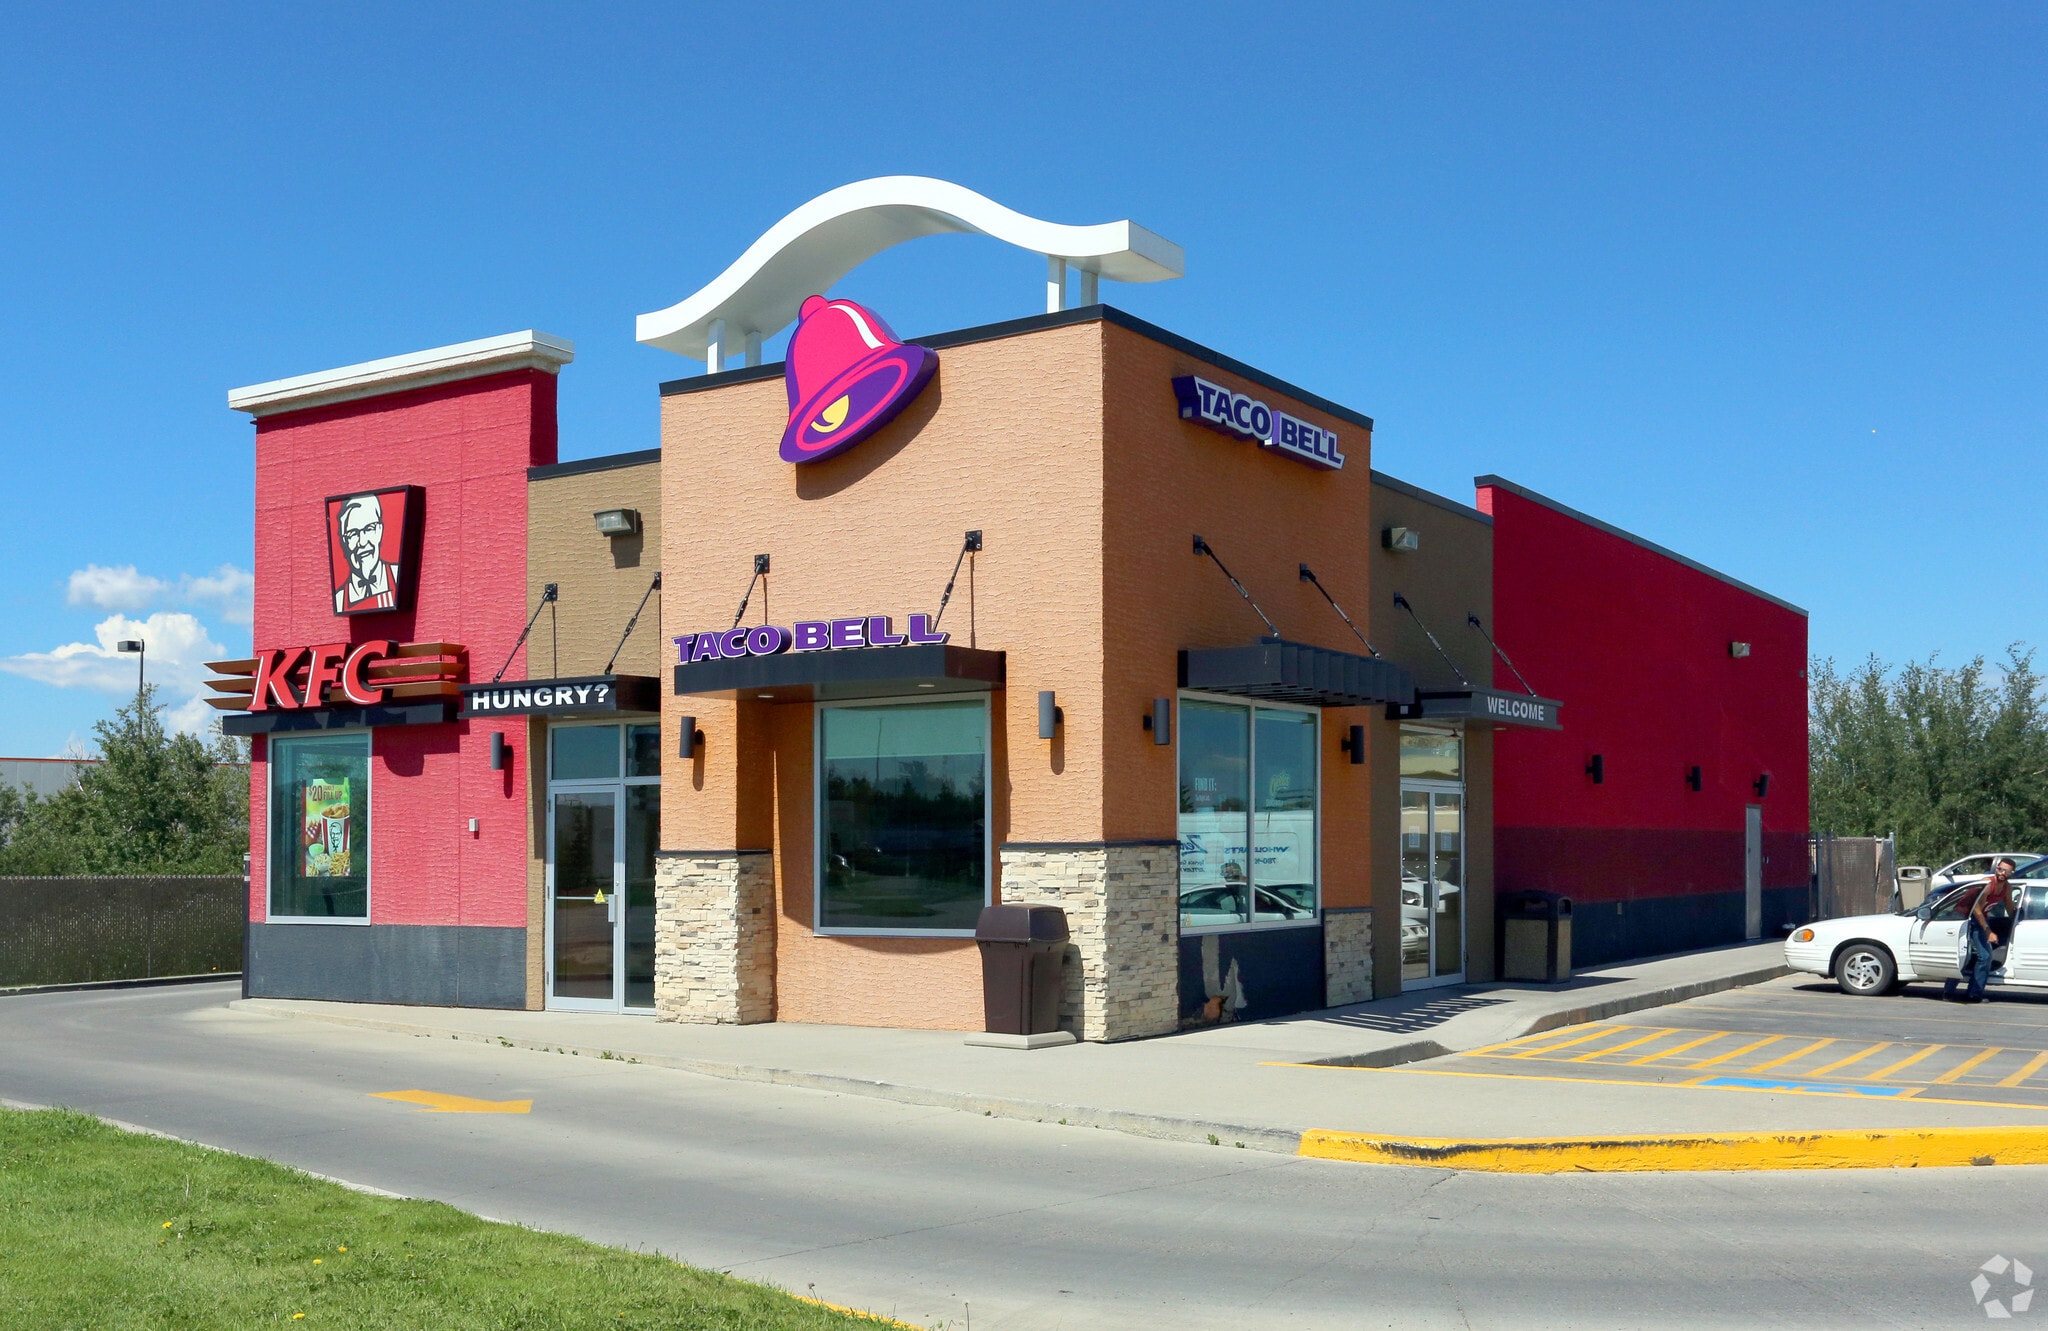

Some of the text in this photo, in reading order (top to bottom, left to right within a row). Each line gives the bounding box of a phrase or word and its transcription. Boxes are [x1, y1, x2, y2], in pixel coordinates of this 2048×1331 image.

[1197, 382, 1342, 465] TACO BELL
[672, 614, 948, 664] TACO BELL
[246, 640, 391, 711] KFC
[471, 683, 610, 711] HUNGRY?
[1487, 696, 1545, 721] WELCOME
[309, 785, 323, 802] $20
